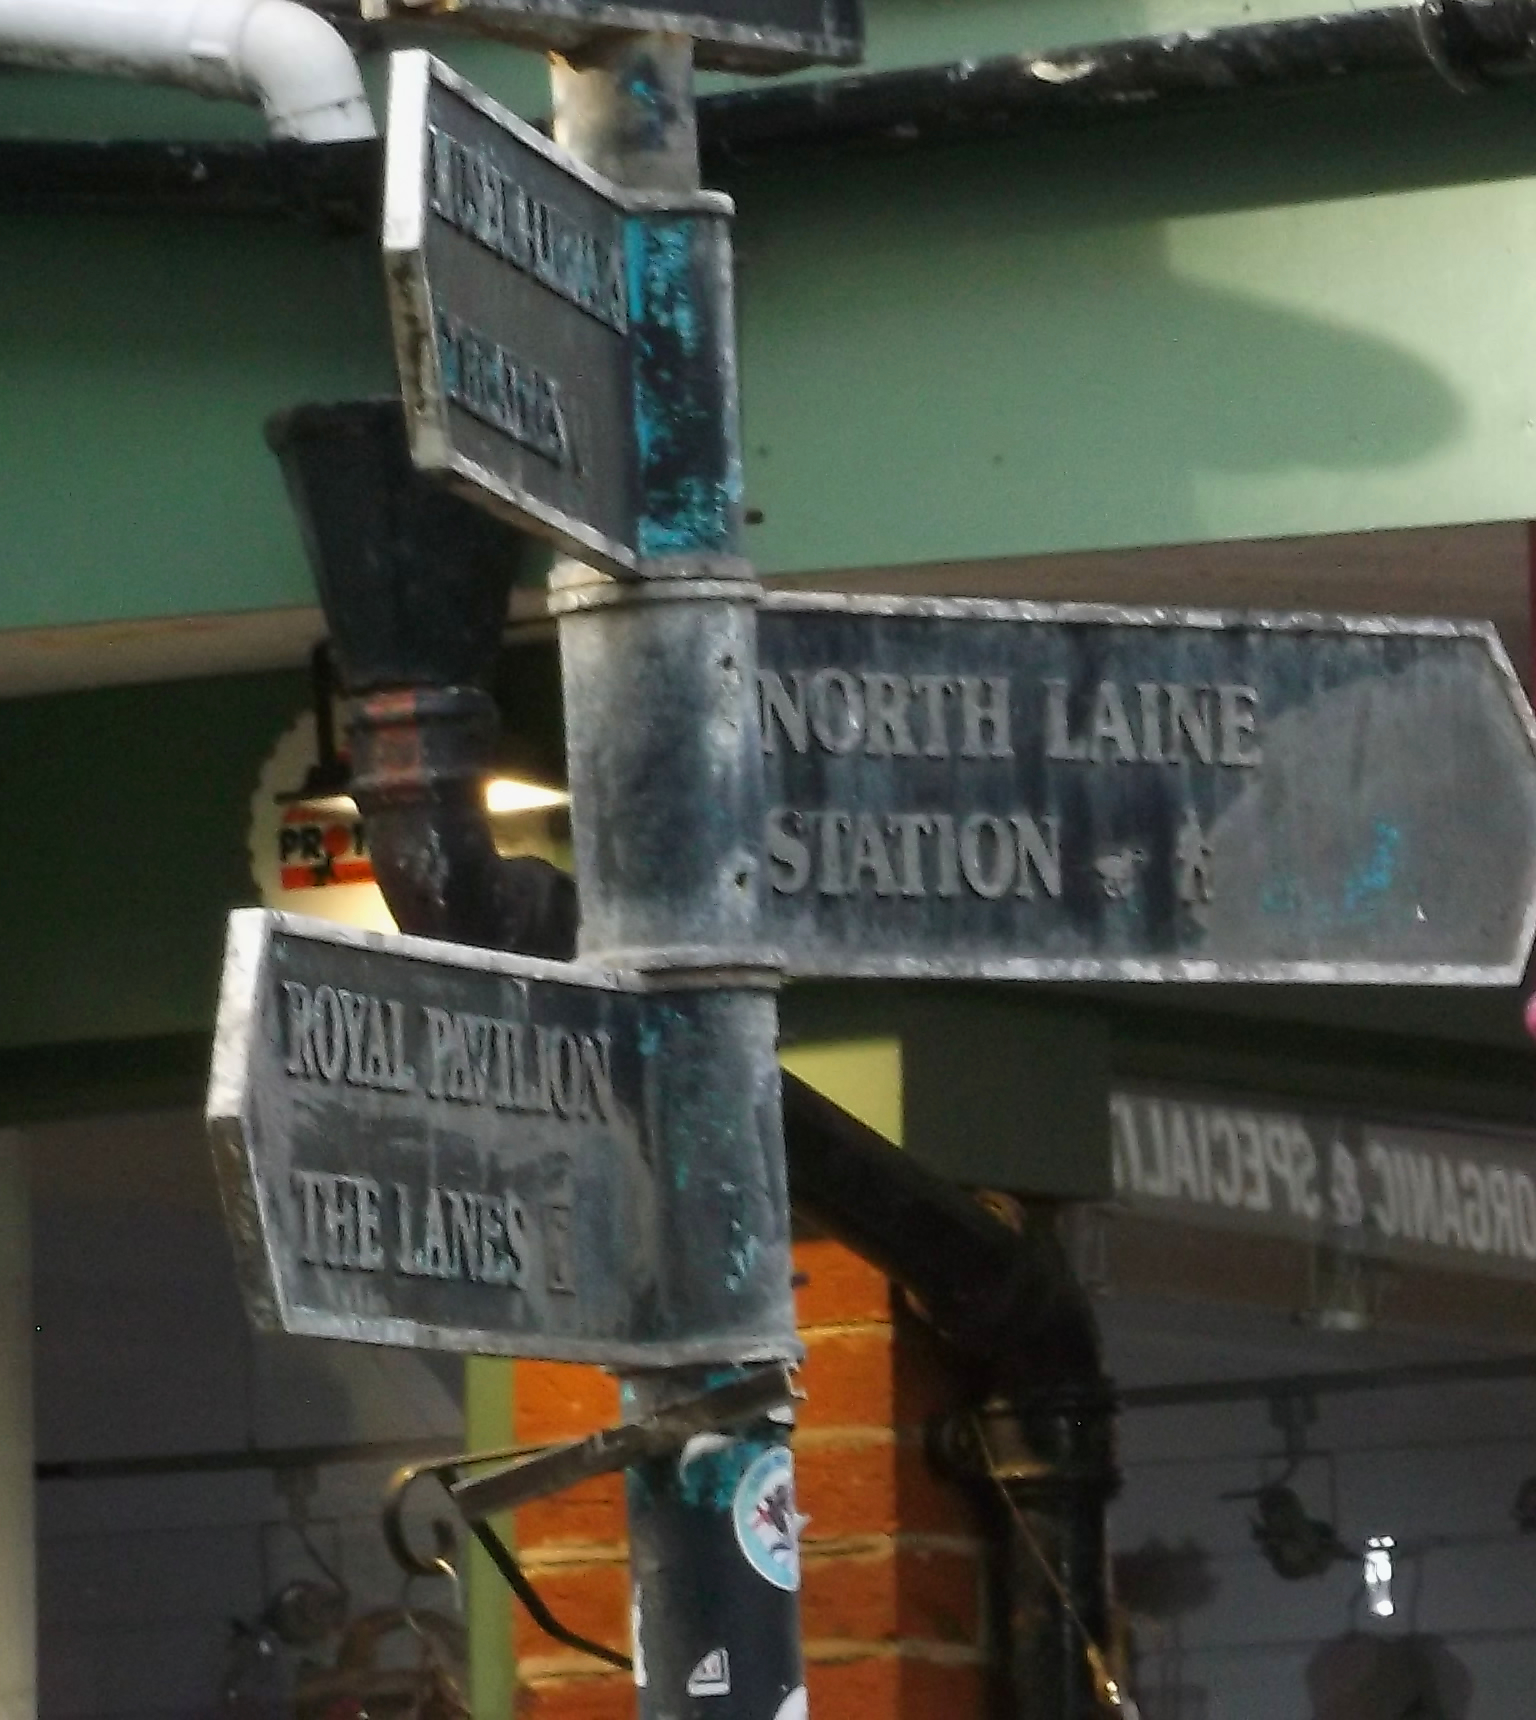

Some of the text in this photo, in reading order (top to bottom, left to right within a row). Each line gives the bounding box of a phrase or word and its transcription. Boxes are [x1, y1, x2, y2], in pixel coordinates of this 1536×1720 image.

[758, 666, 1263, 769] NORTH LAINE
[765, 807, 1066, 902] STATION
[282, 979, 613, 1123] ROYAL PAVILION
[291, 1170, 528, 1290] THE LANES
